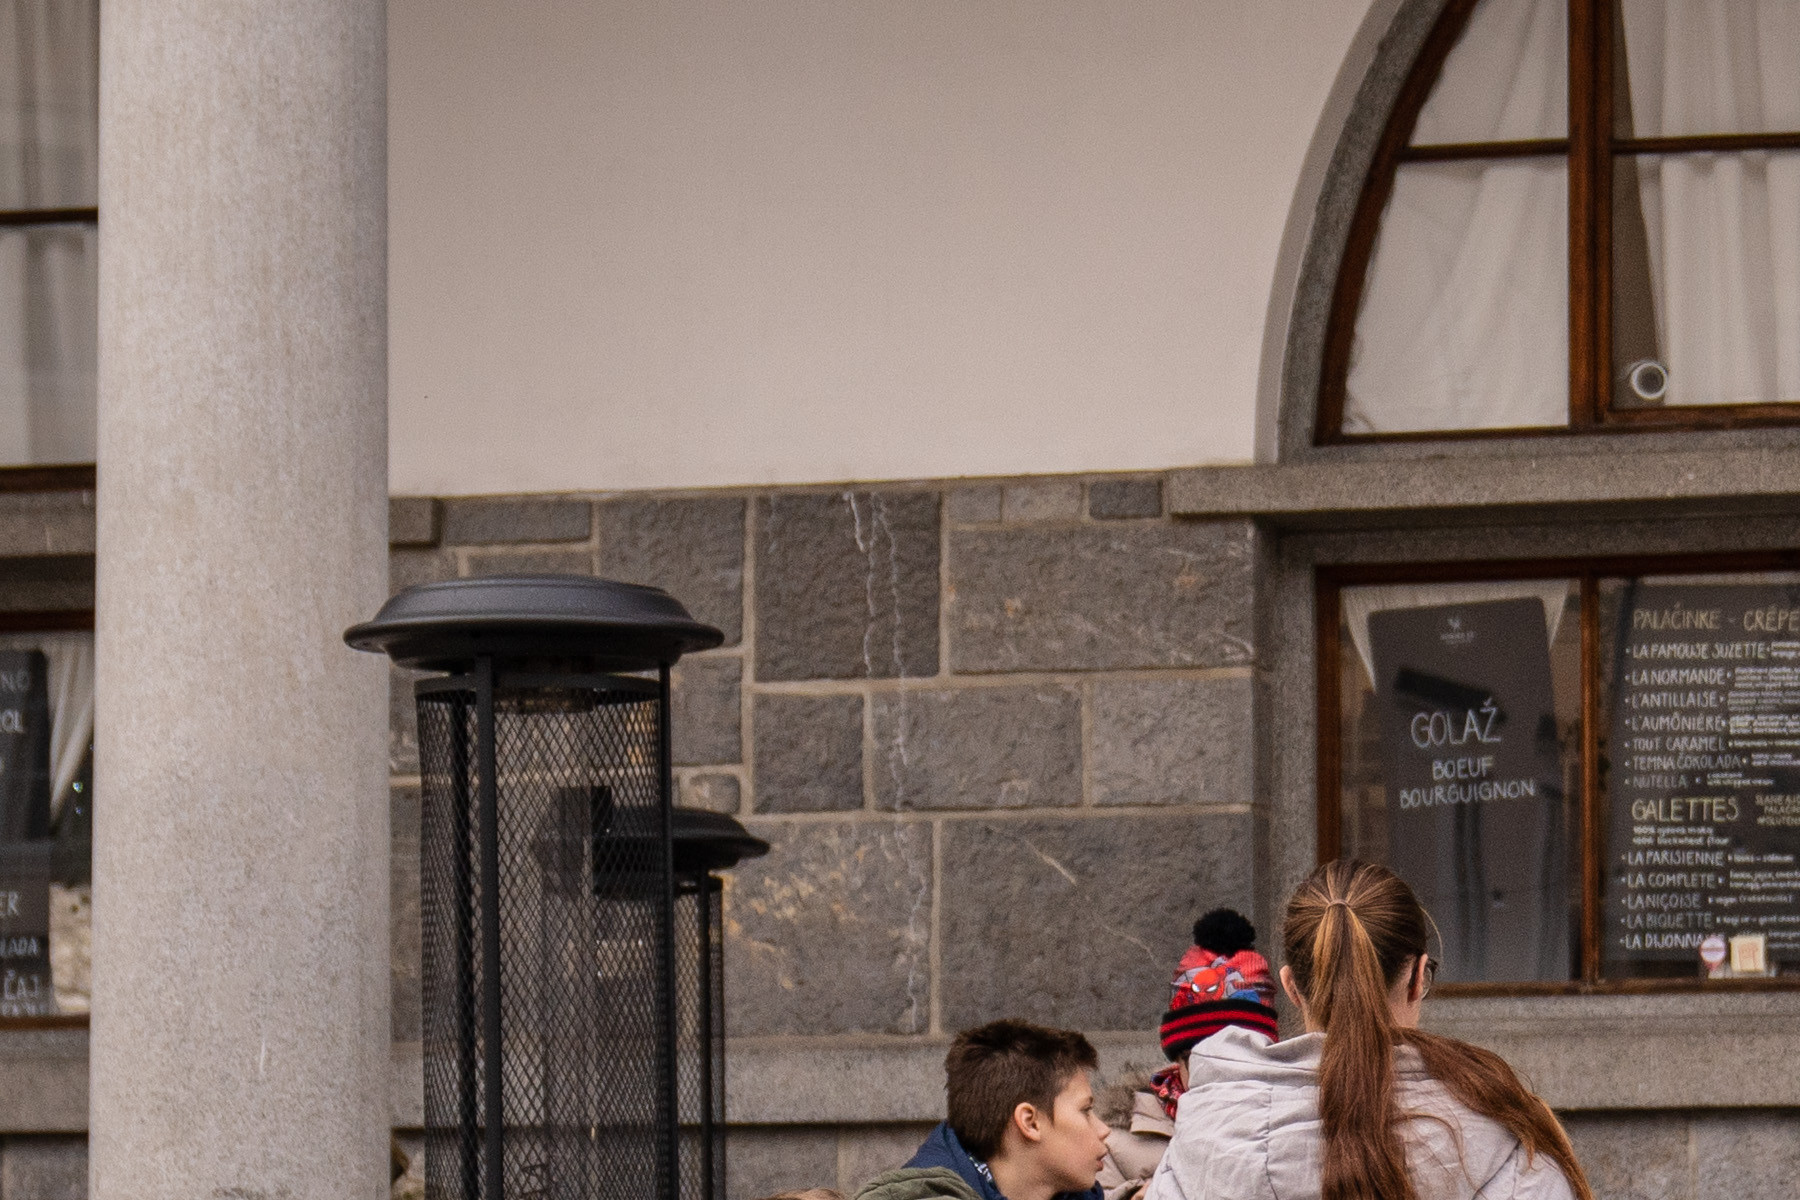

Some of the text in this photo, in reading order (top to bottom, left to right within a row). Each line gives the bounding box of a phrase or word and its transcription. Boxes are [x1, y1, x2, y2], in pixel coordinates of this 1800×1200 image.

[1632, 643, 1650, 659] LA
[1711, 641, 1766, 659] SUZETTE
[1632, 669, 1649, 686] LA
[1651, 667, 1725, 686] NORMANDE
[1633, 737, 1661, 751] TOUT
[1665, 736, 1726, 751] CARAMEL
[1432, 756, 1494, 781] BOEUF
[1633, 755, 1674, 771] TEMNA
[1676, 750, 1741, 770] ČOKOLADA
[1633, 773, 1689, 789] NUTELLA
[1400, 778, 1535, 809] BOURGUIGNON
[1631, 796, 1740, 823] GALETTES
[1627, 851, 1645, 867] LA
[1646, 850, 1725, 867] PARISIENNE
[1627, 873, 1646, 889] LA
[1627, 893, 1648, 910] LA
[1626, 913, 1645, 929] LA
[1625, 932, 1642, 949] LA
